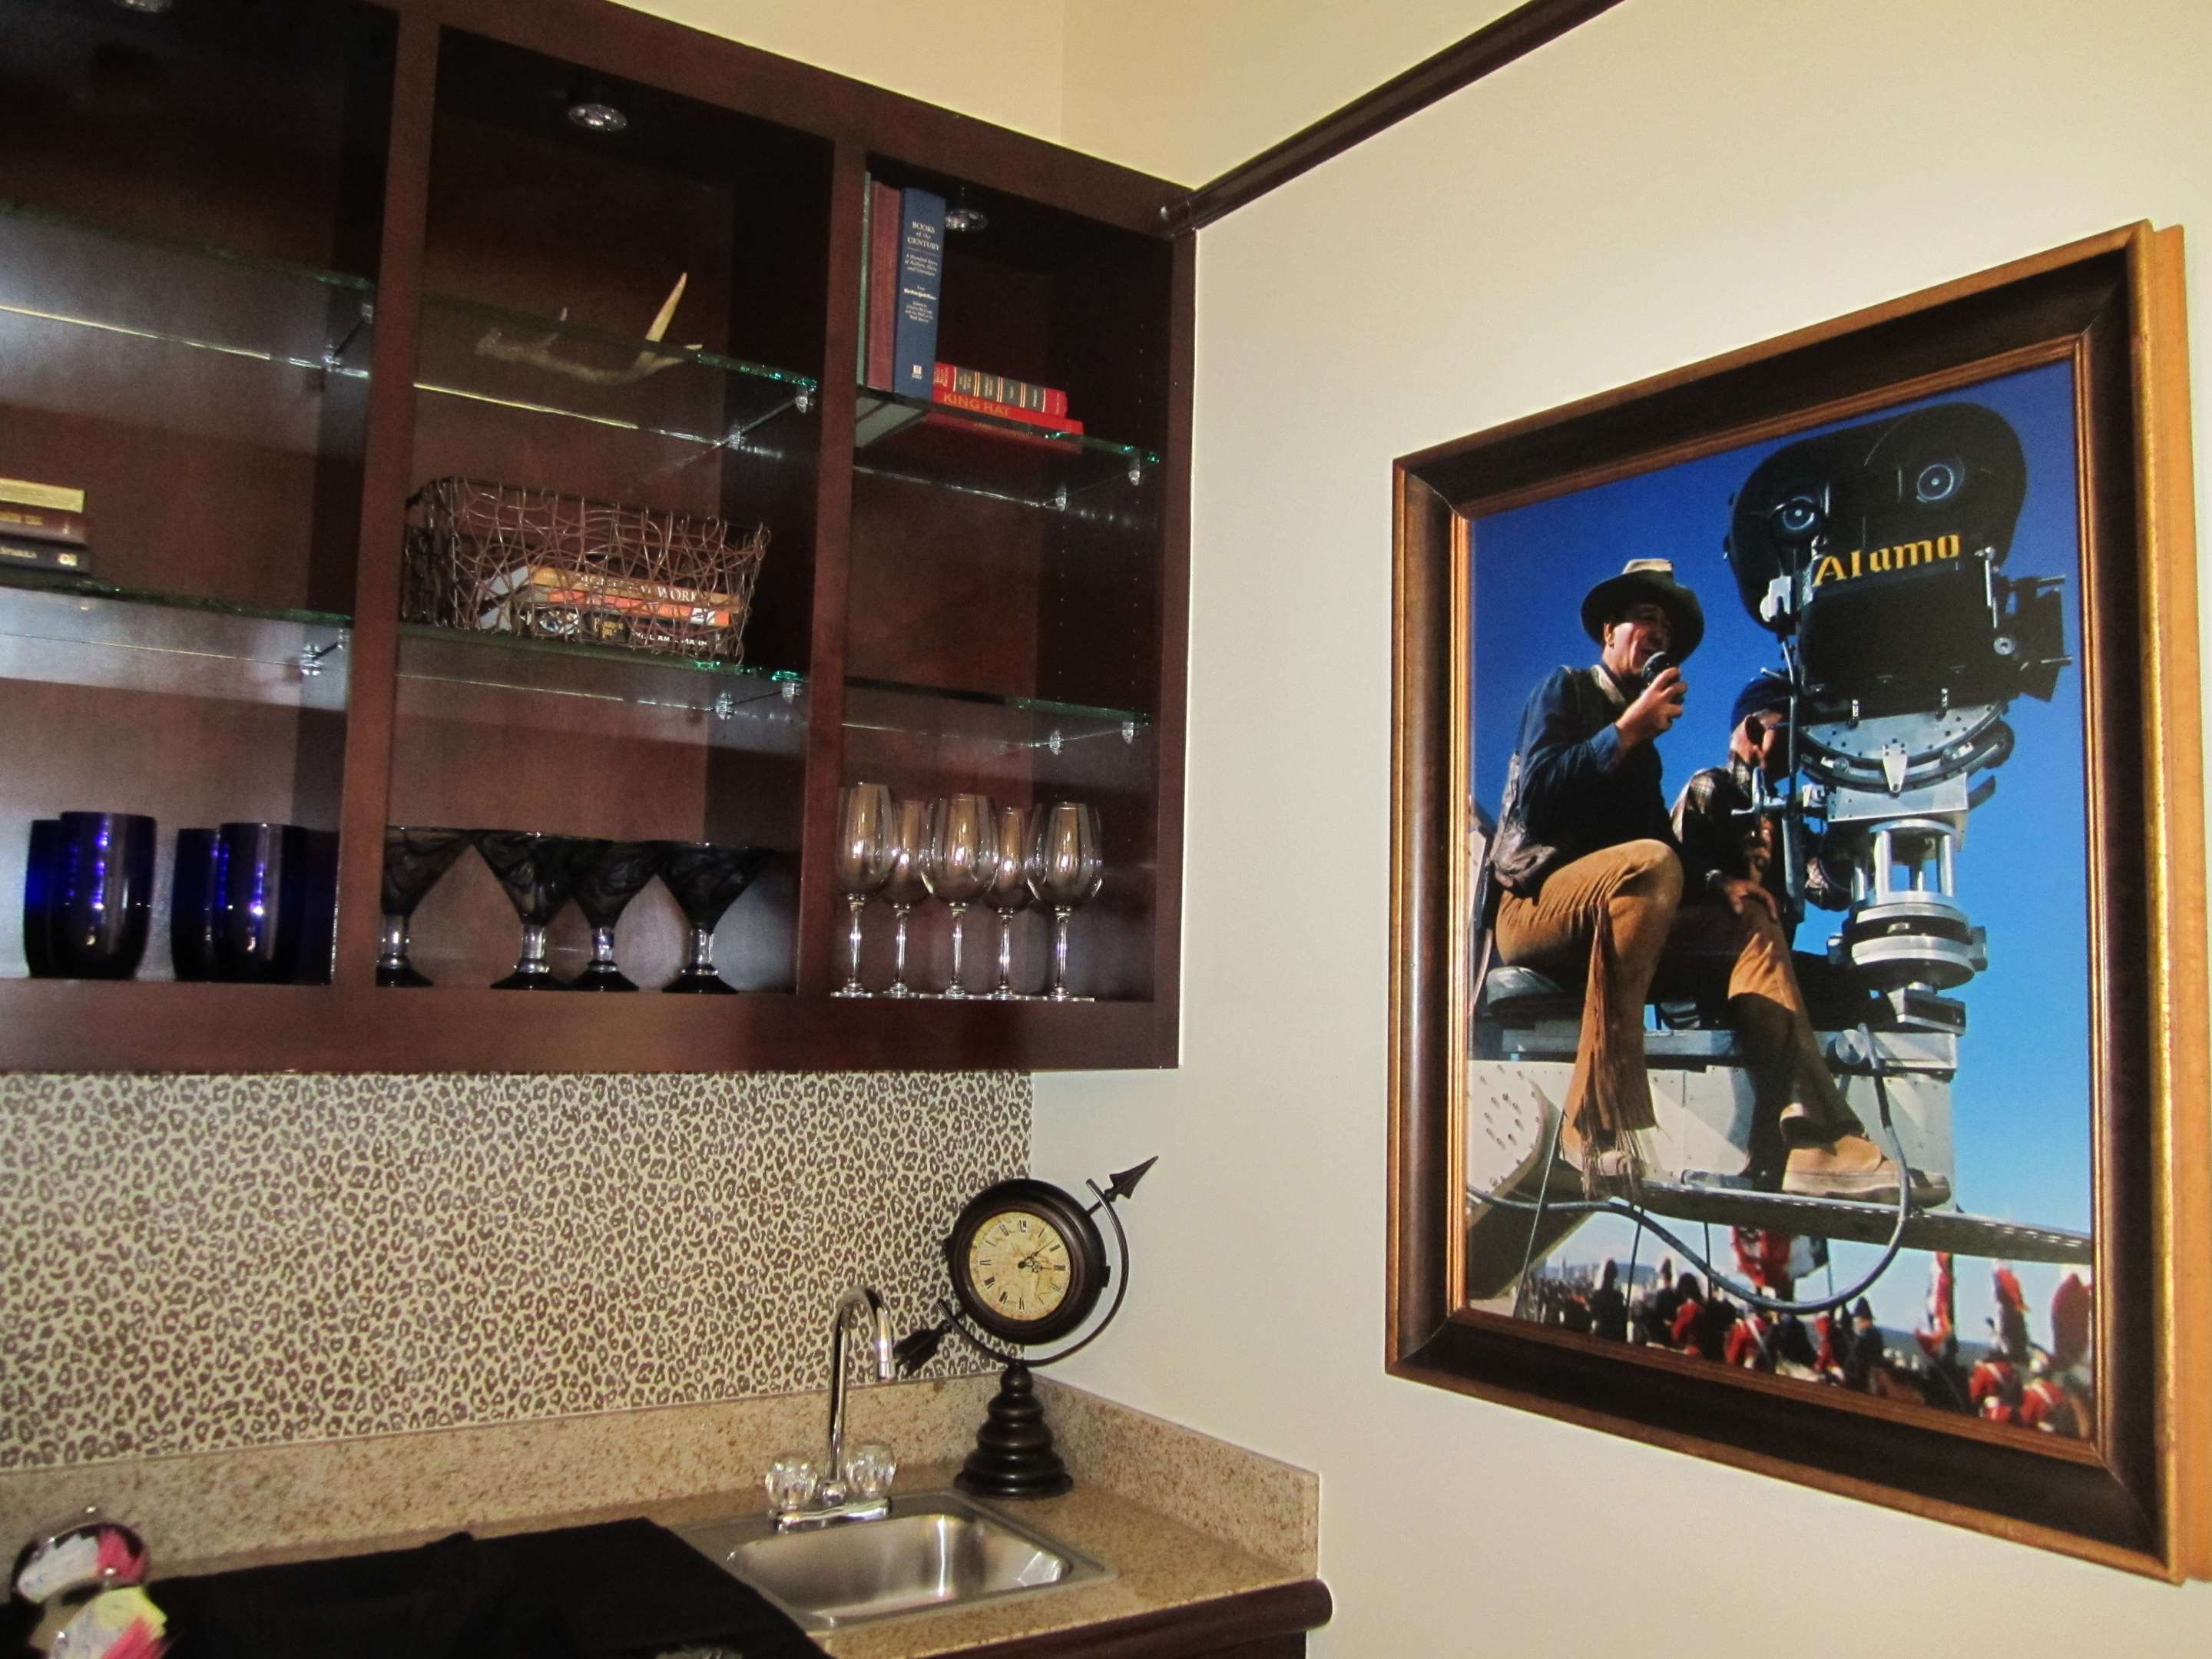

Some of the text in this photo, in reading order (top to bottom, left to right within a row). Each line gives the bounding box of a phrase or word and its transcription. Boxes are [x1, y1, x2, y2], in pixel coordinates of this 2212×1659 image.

[912, 220, 935, 233] BOOKS
[907, 237, 939, 251] CENTURY
[943, 392, 1012, 417] KING RAT
[1812, 534, 1960, 587] Alamo
